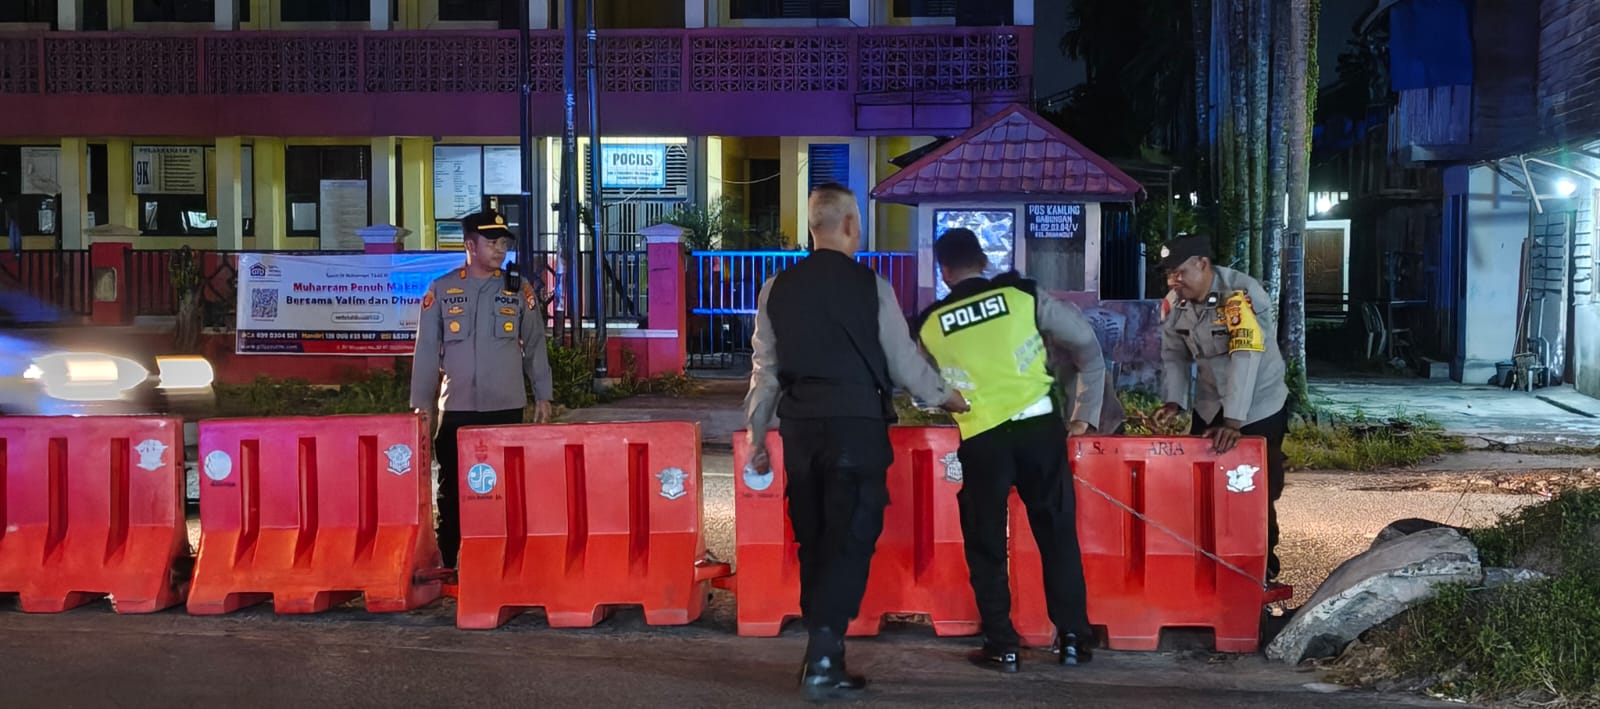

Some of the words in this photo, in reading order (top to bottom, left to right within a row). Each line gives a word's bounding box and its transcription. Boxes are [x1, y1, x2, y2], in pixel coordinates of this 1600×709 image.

[612, 153, 653, 166] POCILS
[136, 161, 150, 185] 9K
[1029, 205, 1045, 215] POS
[293, 282, 348, 292] Muharram
[350, 282, 383, 292] Penuh
[286, 296, 333, 305] Bersama
[335, 296, 366, 305] Yatim
[368, 296, 388, 305] dan
[391, 296, 421, 305] Dhua
[443, 296, 468, 304] YUDI
[940, 295, 1006, 332] POLISI
